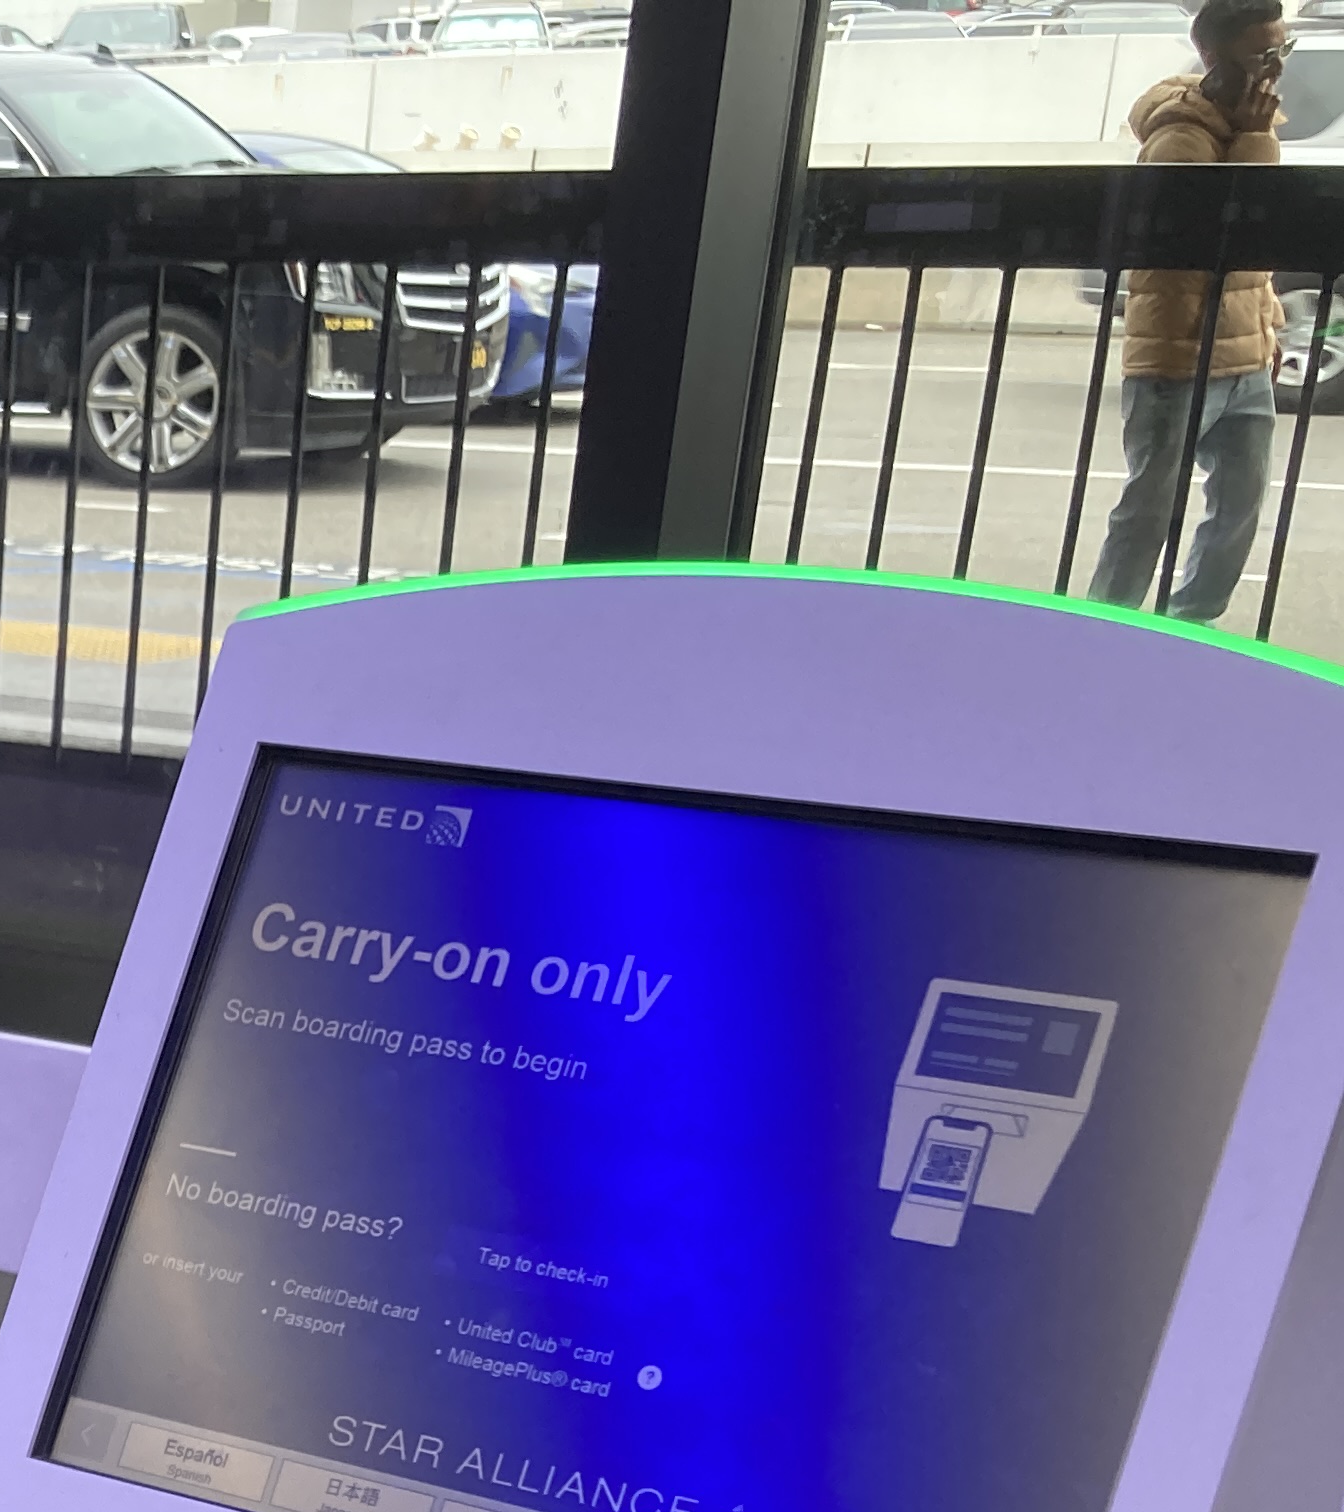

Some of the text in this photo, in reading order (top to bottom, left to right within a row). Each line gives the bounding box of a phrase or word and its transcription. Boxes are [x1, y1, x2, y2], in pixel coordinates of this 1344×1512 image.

[279, 795, 424, 832] UNITED
[251, 903, 672, 1023] Carry-on only
[223, 999, 588, 1081] Scan boarding pass to begin
[165, 1173, 403, 1241] No boarding pass?
[142, 1252, 244, 1285] or insert your
[478, 1247, 609, 1289] Tap to check-in
[282, 1279, 419, 1322] Credit/Debit card
[273, 1306, 345, 1337] Passport
[457, 1318, 513, 1345] United
[573, 1342, 613, 1365] card
[570, 1375, 611, 1397] card
[163, 1438, 230, 1469] Español
[328, 1415, 444, 1468] STAR
[166, 1464, 212, 1486] Spanish
[325, 1478, 381, 1508] 日本語
